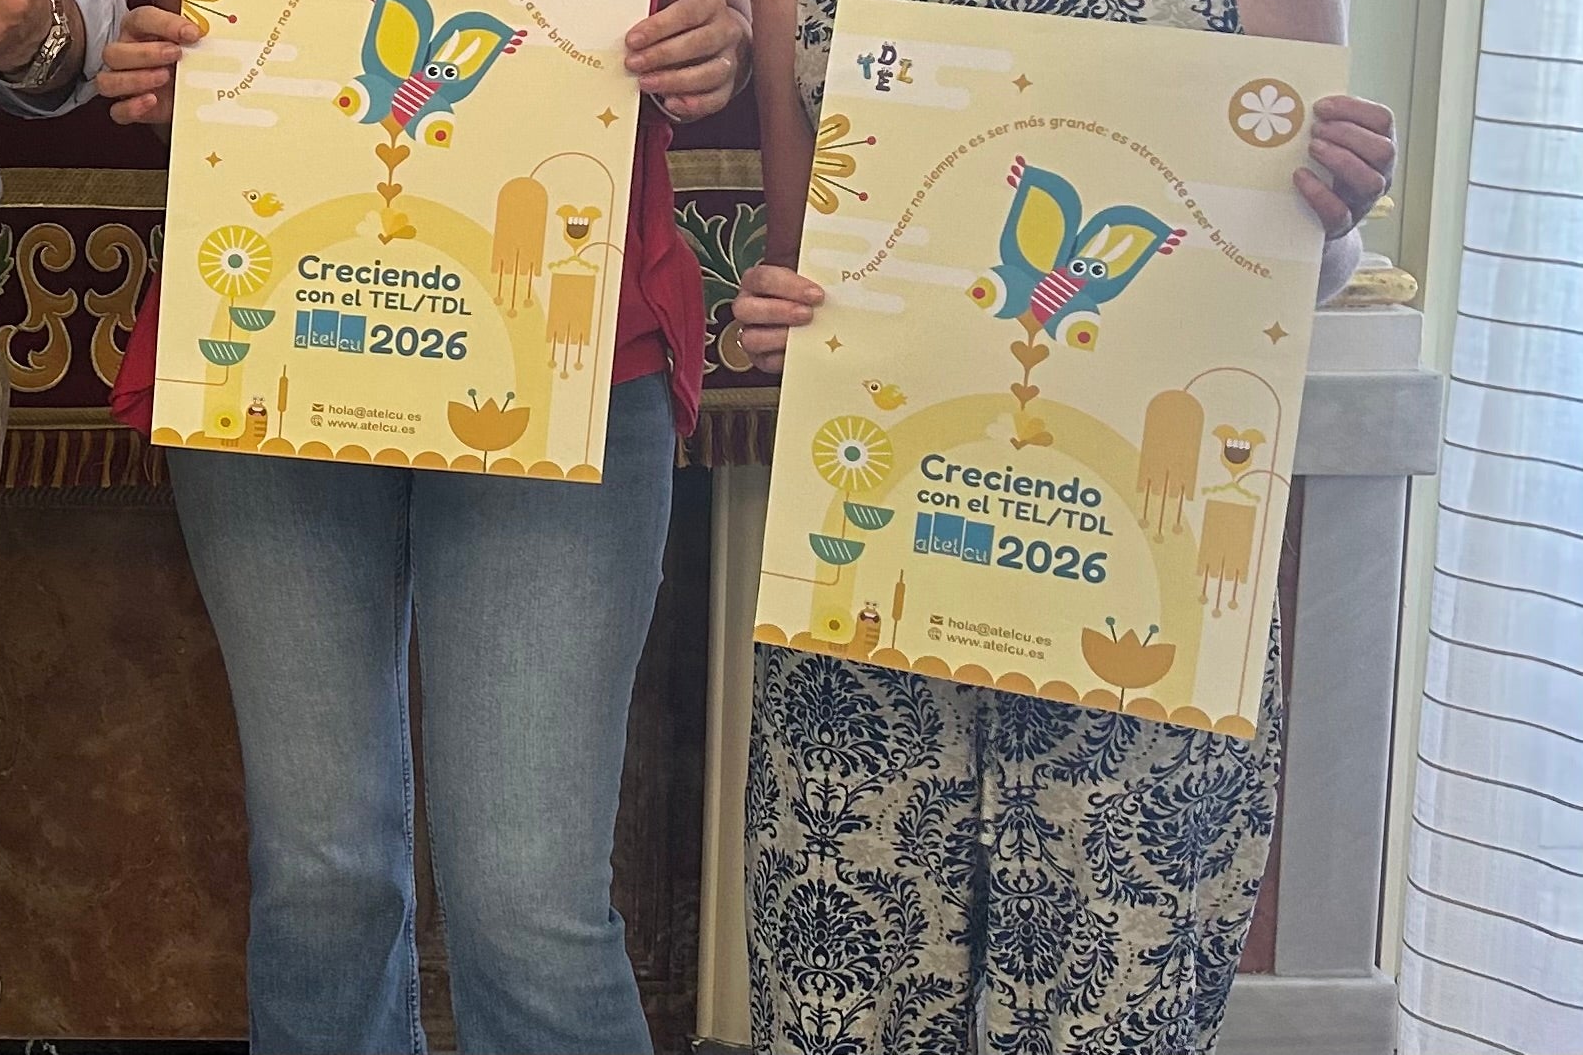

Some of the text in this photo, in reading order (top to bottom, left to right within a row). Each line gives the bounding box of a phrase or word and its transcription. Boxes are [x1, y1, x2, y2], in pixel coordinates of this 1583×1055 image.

[217, 68, 259, 101] Porque
[256, 27, 281, 67] crecer
[278, 9, 291, 26] no
[532, 11, 550, 29] ser
[842, 249, 888, 283] Porque
[885, 208, 913, 249] crecer
[910, 190, 925, 208] no
[923, 146, 967, 190] siempre
[969, 135, 985, 148] es
[987, 124, 1009, 140] ser
[1014, 115, 1045, 130] más
[1111, 132, 1128, 146] es
[1130, 141, 1188, 199] atreverte
[1192, 209, 1214, 231] ser
[298, 255, 461, 292] Creciendo
[296, 289, 472, 316] con el TEL/TDL
[369, 324, 468, 360] 2026
[327, 420, 416, 434] www.atelcu.es
[329, 404, 421, 422] hola@atelcu.es
[921, 454, 1101, 508] Creciendo
[917, 490, 1113, 536] con el TEL/TDL
[996, 535, 1108, 584] 2026
[946, 634, 1044, 660] www.atelcu.es
[948, 617, 1052, 646] hola@atelcu.es
